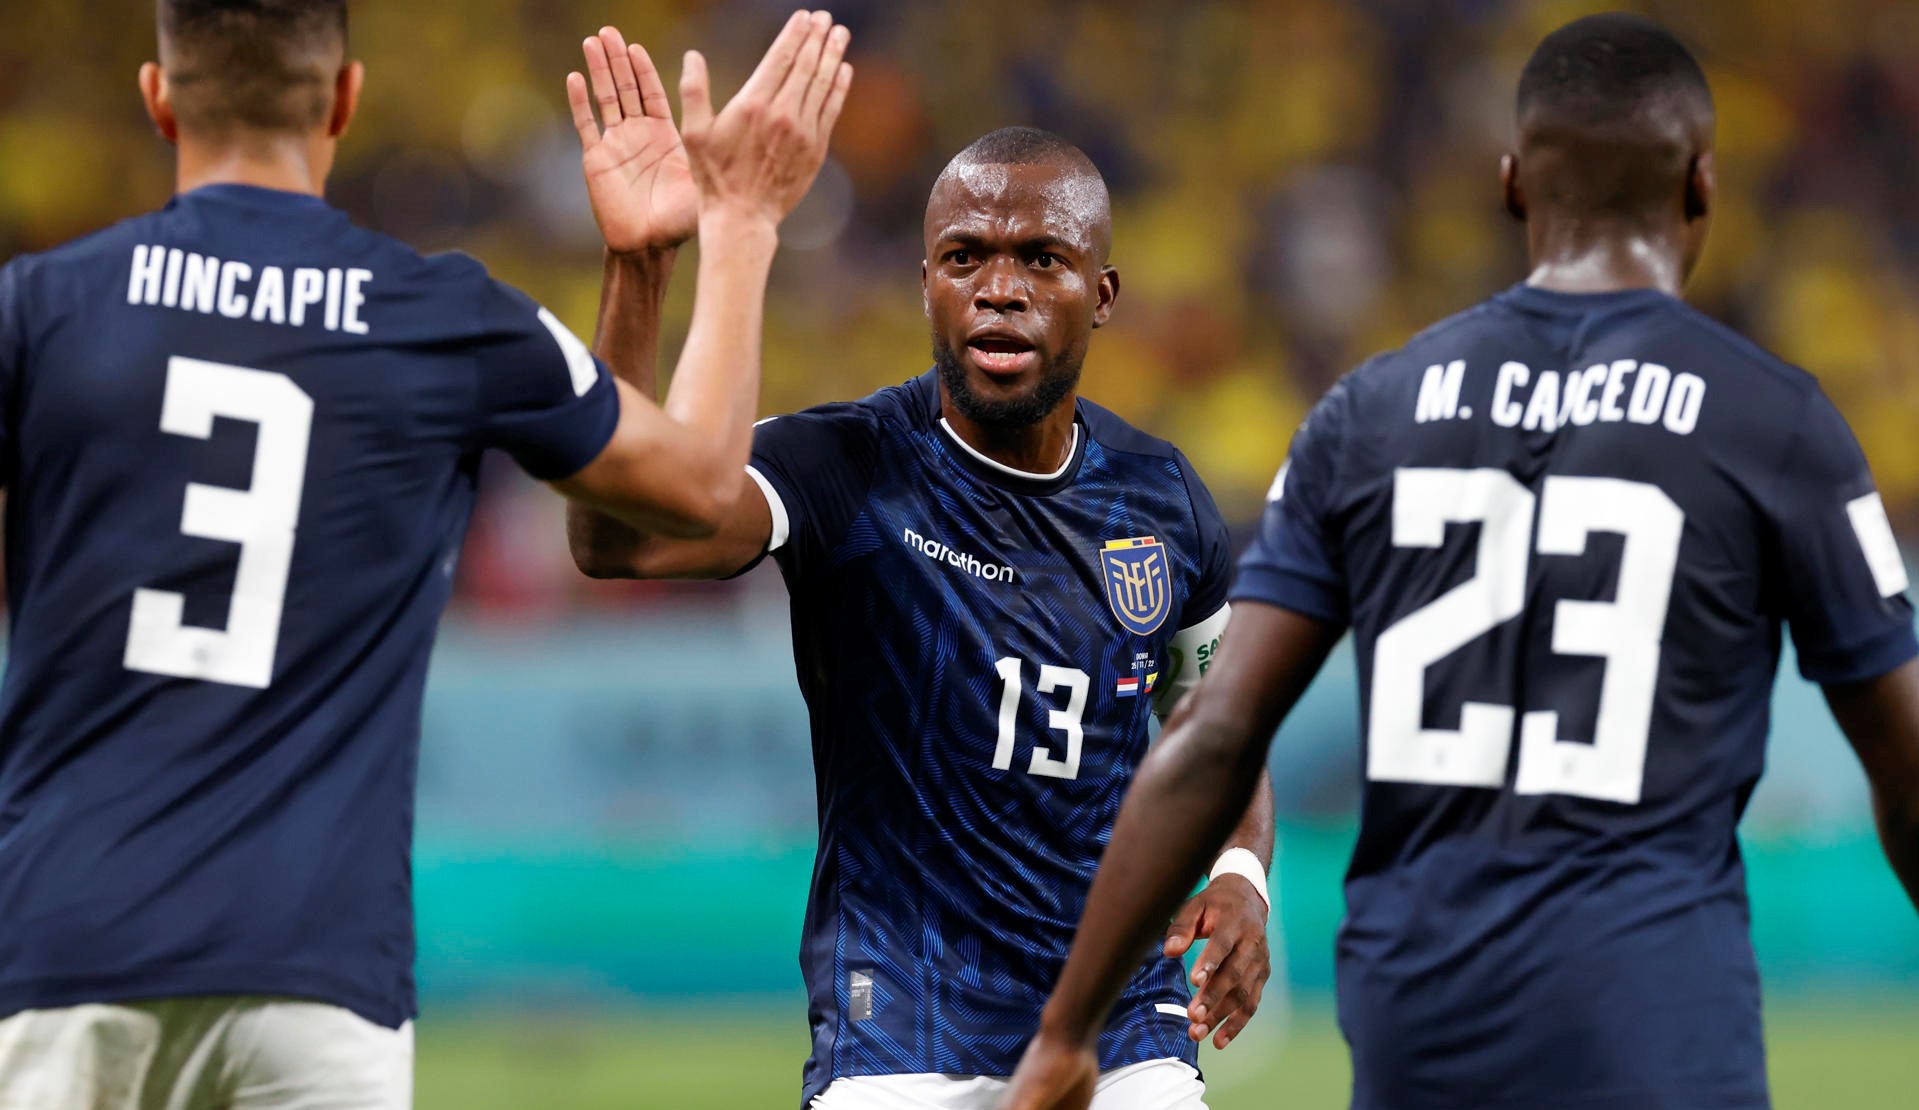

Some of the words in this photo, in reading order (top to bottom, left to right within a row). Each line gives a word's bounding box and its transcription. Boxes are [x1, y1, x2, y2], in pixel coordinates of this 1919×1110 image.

[127, 244, 373, 335] HINCAPIE
[1414, 359, 1473, 424] M.
[1490, 359, 1706, 435] CAICEDO
[123, 355, 314, 689] 3
[904, 528, 1014, 583] marathon
[1367, 466, 1686, 804] 23
[992, 656, 1090, 780] 13
